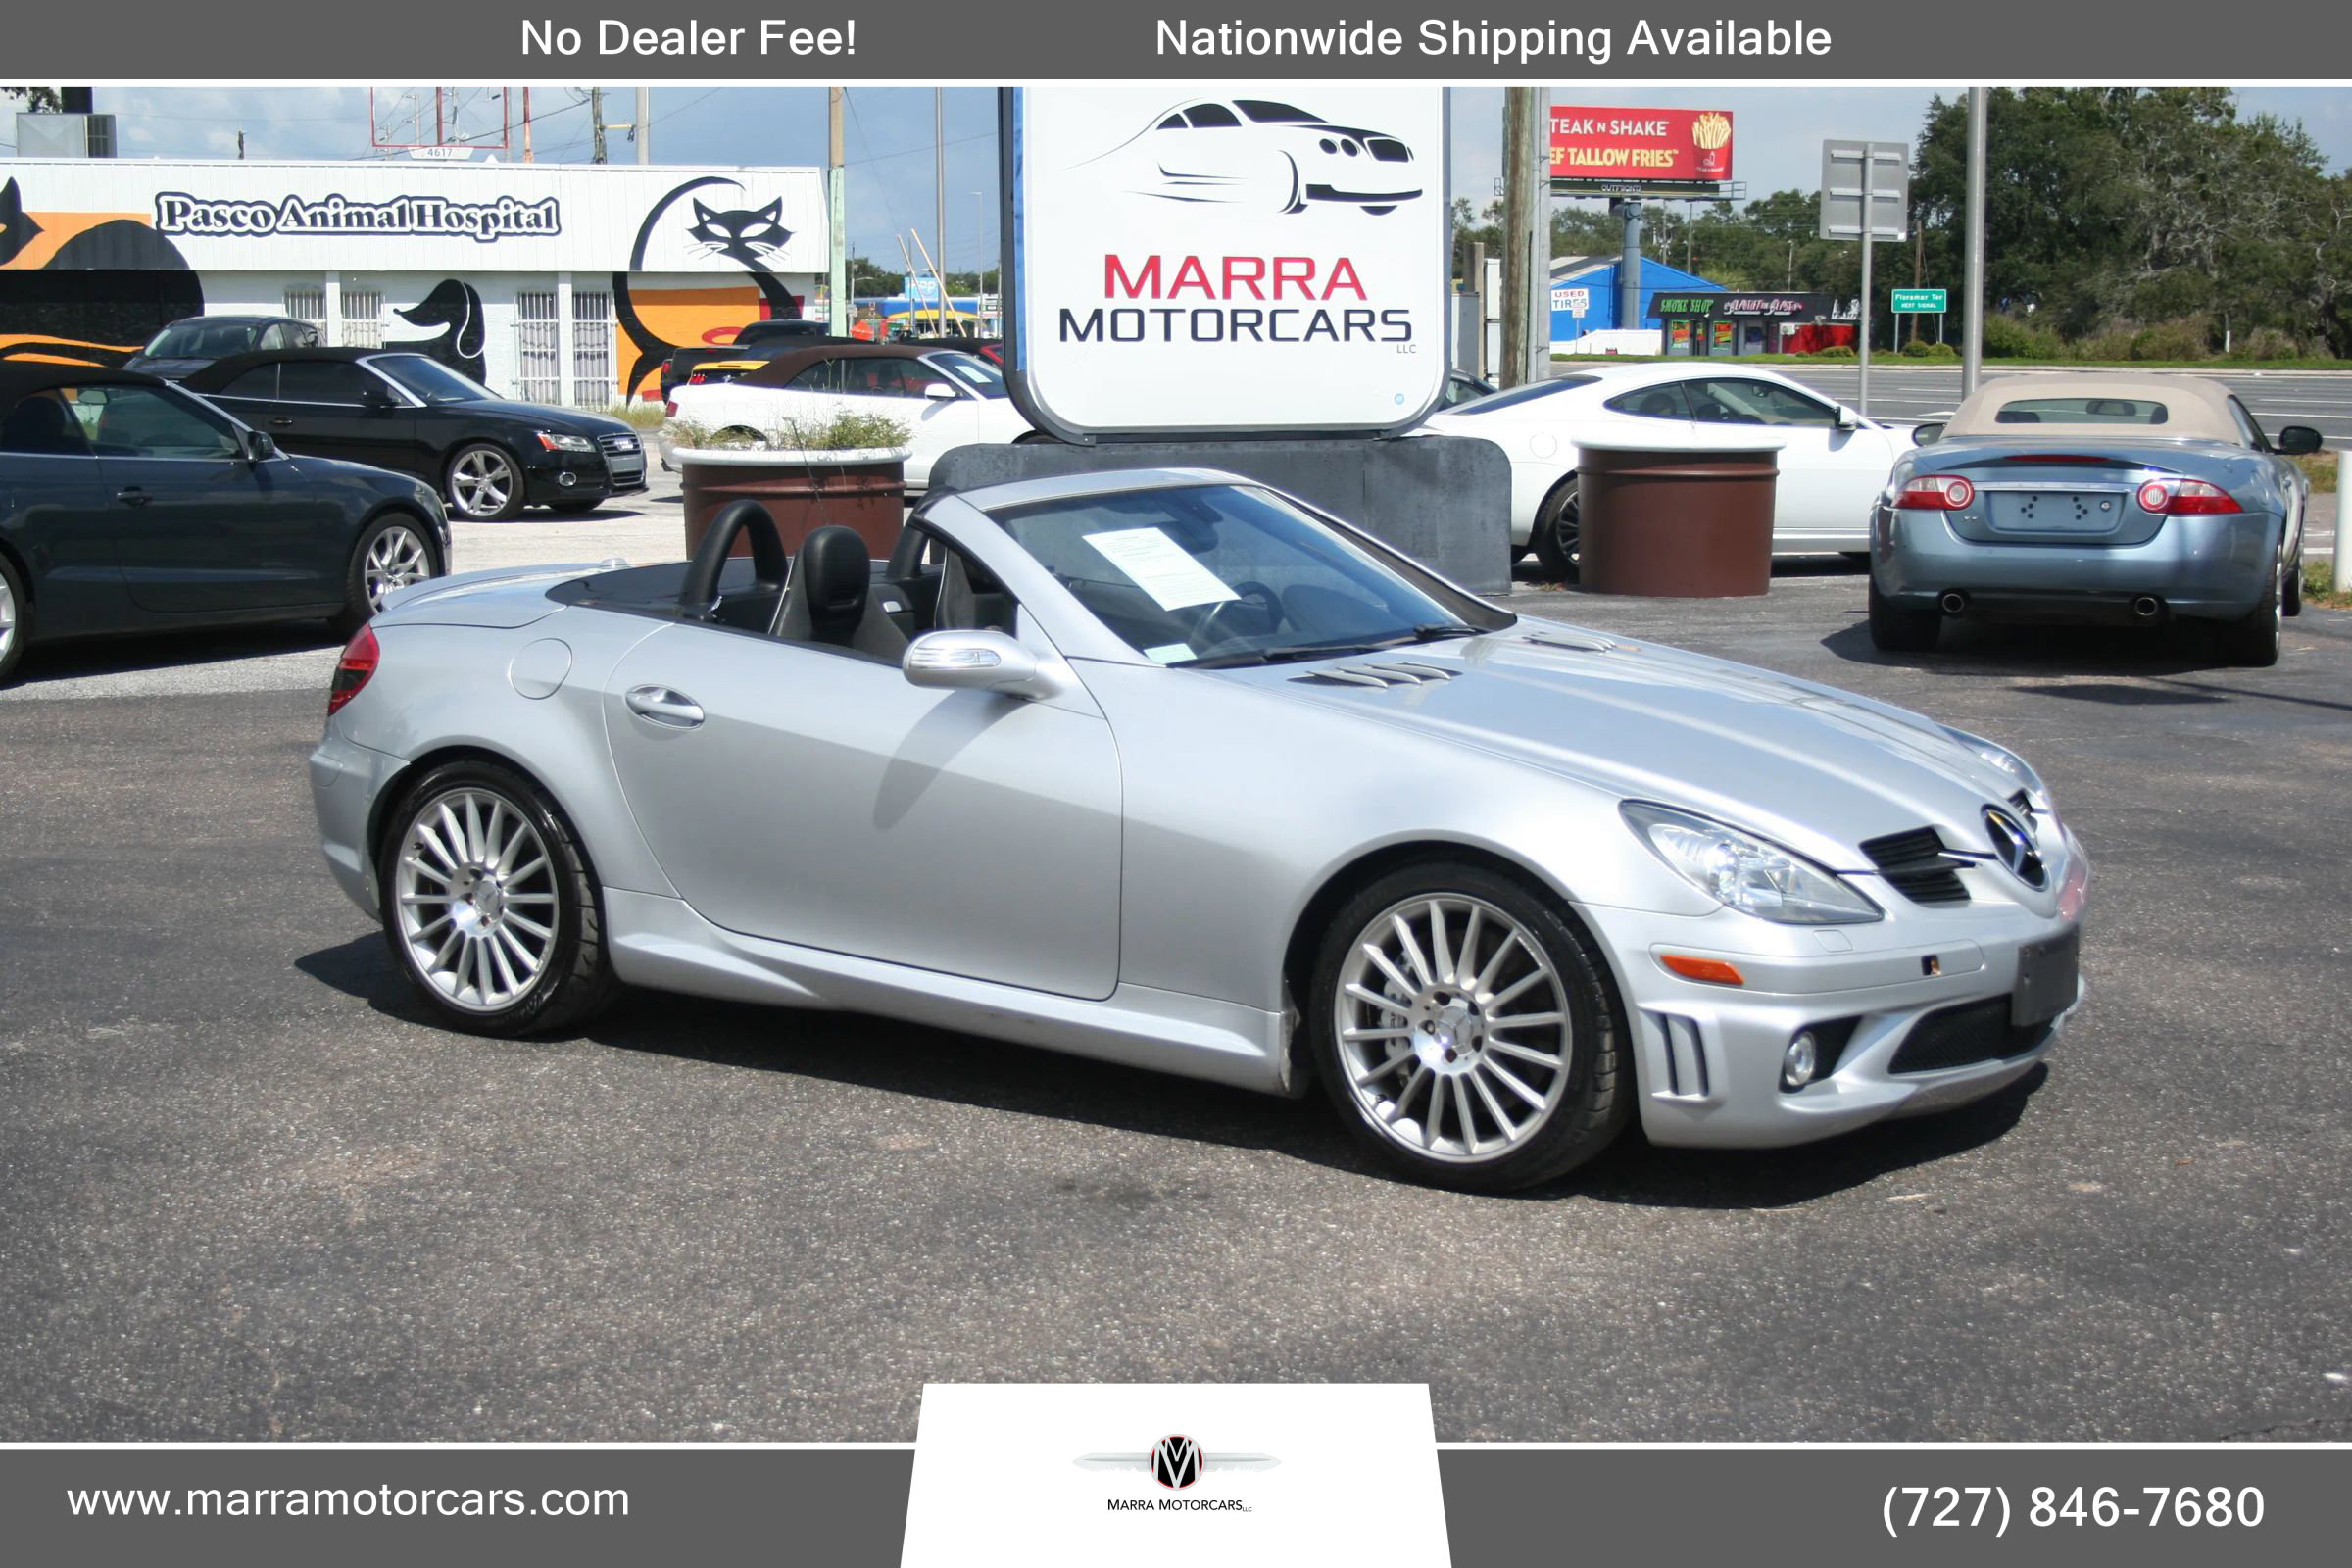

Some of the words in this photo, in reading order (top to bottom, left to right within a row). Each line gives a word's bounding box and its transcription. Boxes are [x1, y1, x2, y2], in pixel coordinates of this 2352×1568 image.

[1549, 118, 1594, 135] TEAK
[426, 148, 453, 158] 4617
[1568, 148, 1628, 166] TALLOW
[160, 196, 276, 232] Pasco
[278, 196, 410, 232] Animal
[414, 197, 559, 238] Hospital
[1104, 254, 1367, 301] MARRA
[1690, 298, 1714, 313] SHOP
[1059, 308, 1412, 342] MOTORCARS
[1396, 344, 1417, 354] LLC
